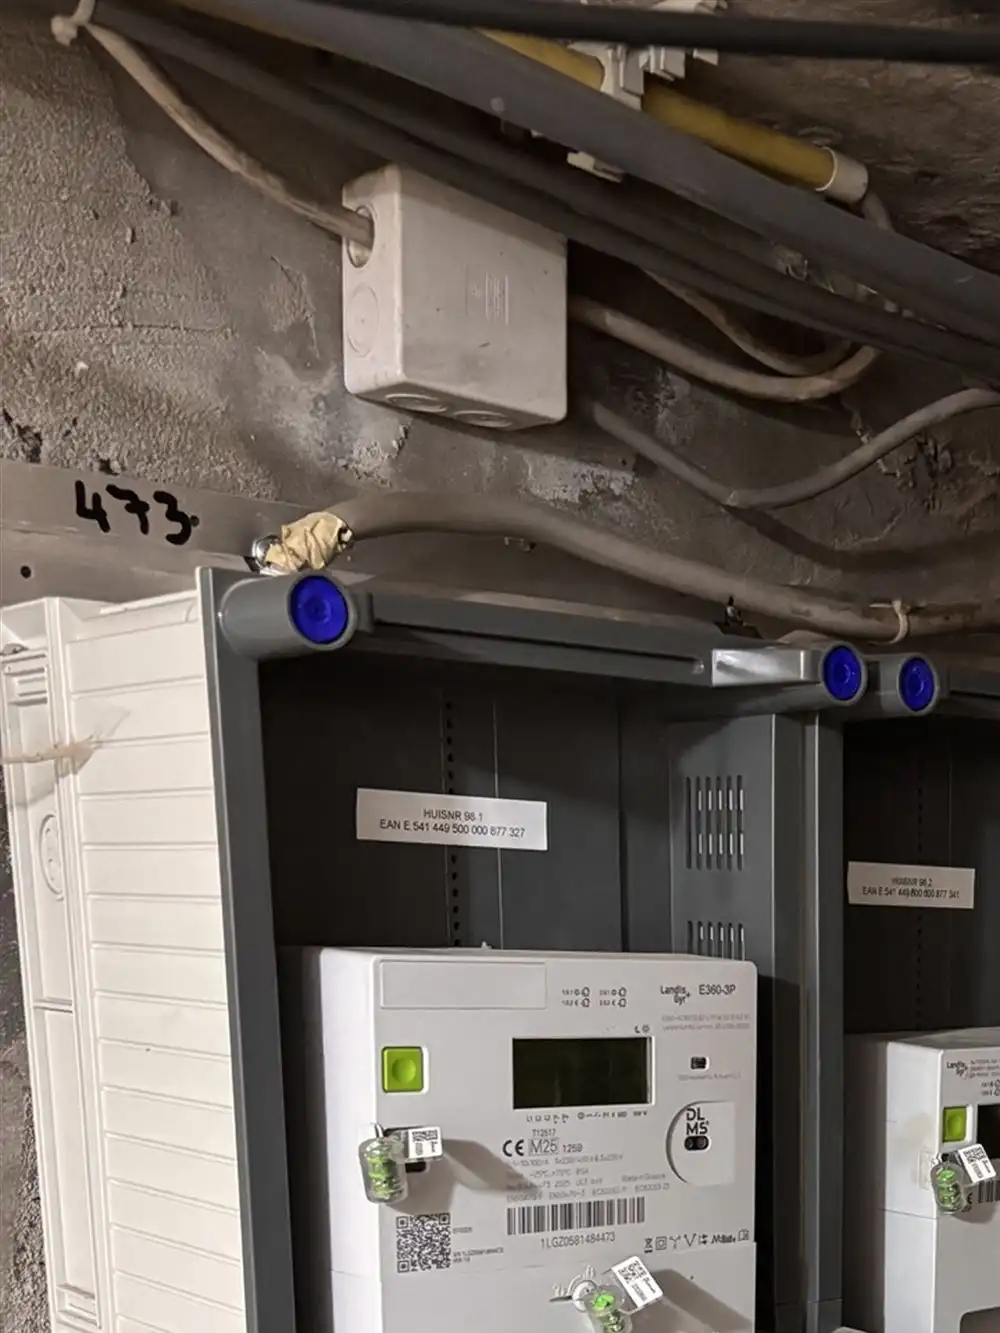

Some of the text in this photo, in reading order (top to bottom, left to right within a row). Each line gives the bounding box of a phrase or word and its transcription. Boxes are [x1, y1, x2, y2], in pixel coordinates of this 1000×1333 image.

[75, 480, 191, 545] 473
[423, 808, 462, 821] HUISNR
[380, 818, 401, 830] EAN
[403, 820, 411, 831] E
[412, 821, 430, 832] 541
[432, 822, 450, 834] 449
[452, 823, 470, 835] 500
[471, 824, 489, 836] 000
[509, 826, 526, 838] 327
[698, 983, 736, 995] E360-3P
[530, 1138, 558, 1154] M25
